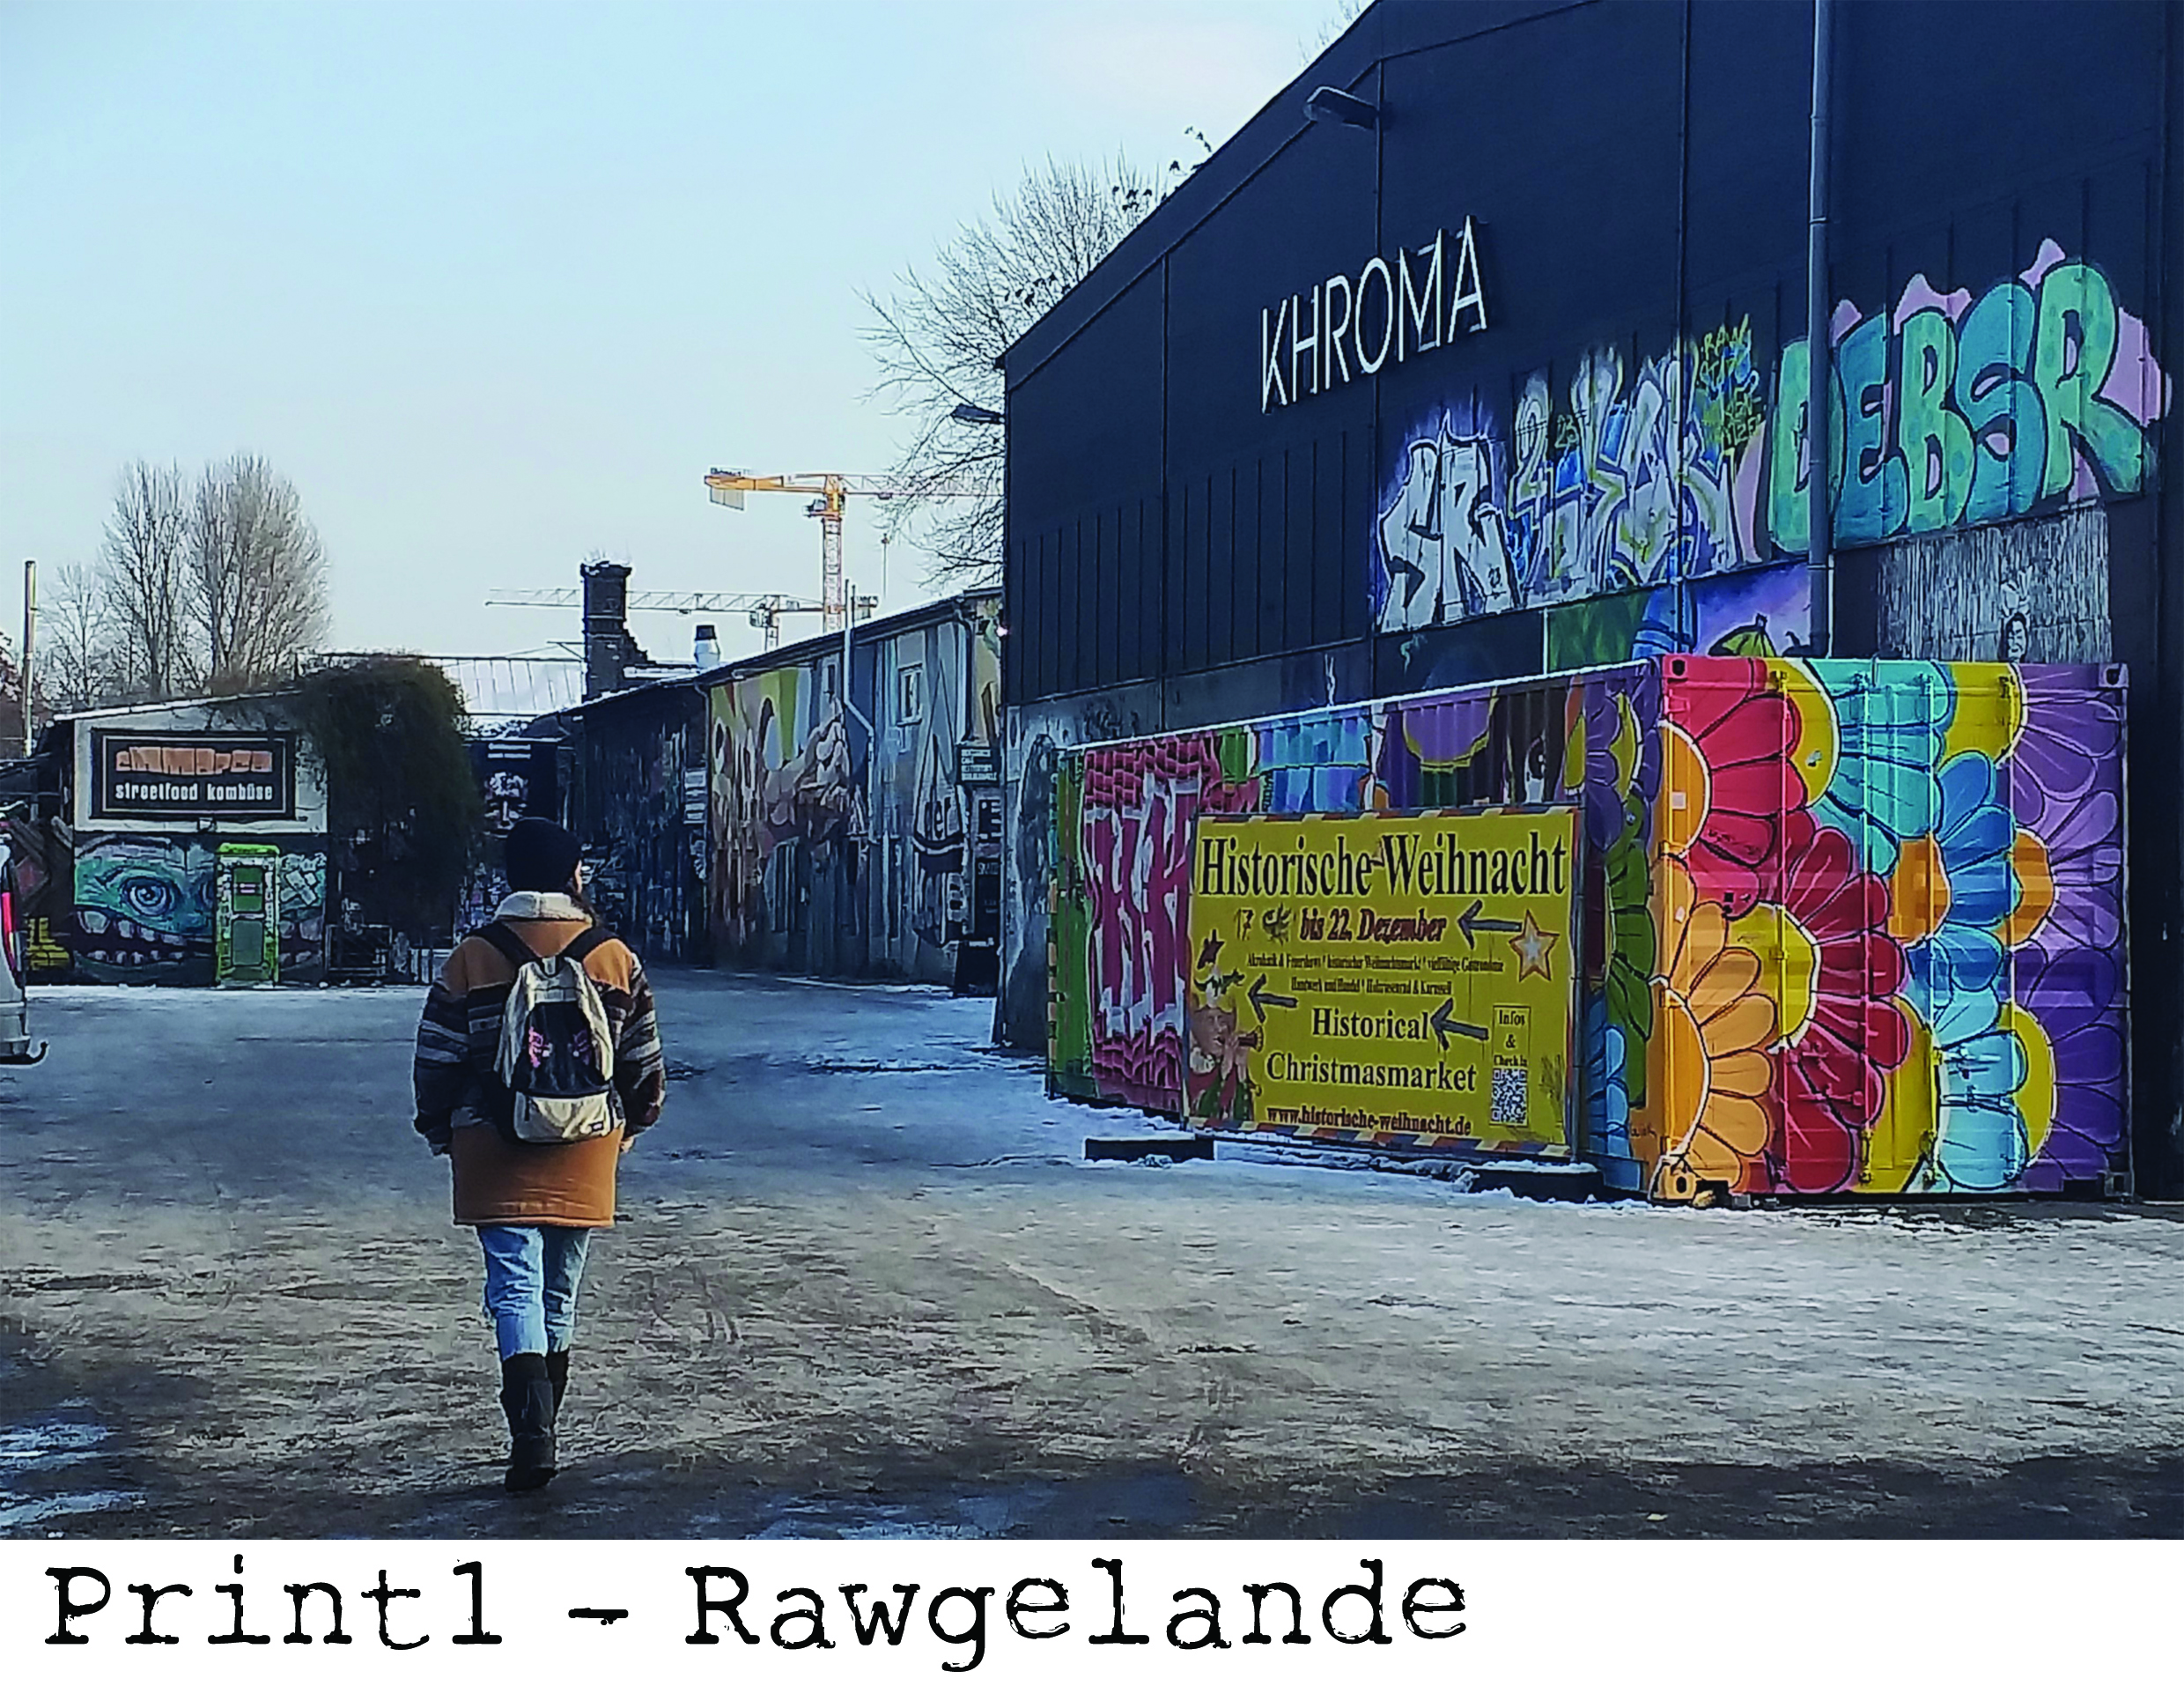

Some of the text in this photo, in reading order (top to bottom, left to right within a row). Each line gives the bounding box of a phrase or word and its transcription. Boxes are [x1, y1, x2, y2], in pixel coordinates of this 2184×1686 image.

[1261, 214, 1488, 414] KHROMA
[114, 781, 199, 802] streetfood
[1199, 831, 1567, 897] Historische Weihnacht
[1300, 907, 1324, 941] bis
[1327, 907, 1354, 942] 22.
[1356, 907, 1448, 944] Dezember
[1312, 1008, 1428, 1039] Historical
[1499, 1009, 1525, 1025] Infos
[1505, 1034, 1516, 1048] &
[1265, 1052, 1477, 1091] Christmasmarket
[1266, 1106, 1472, 1136] www.historische-weihnacht.de
